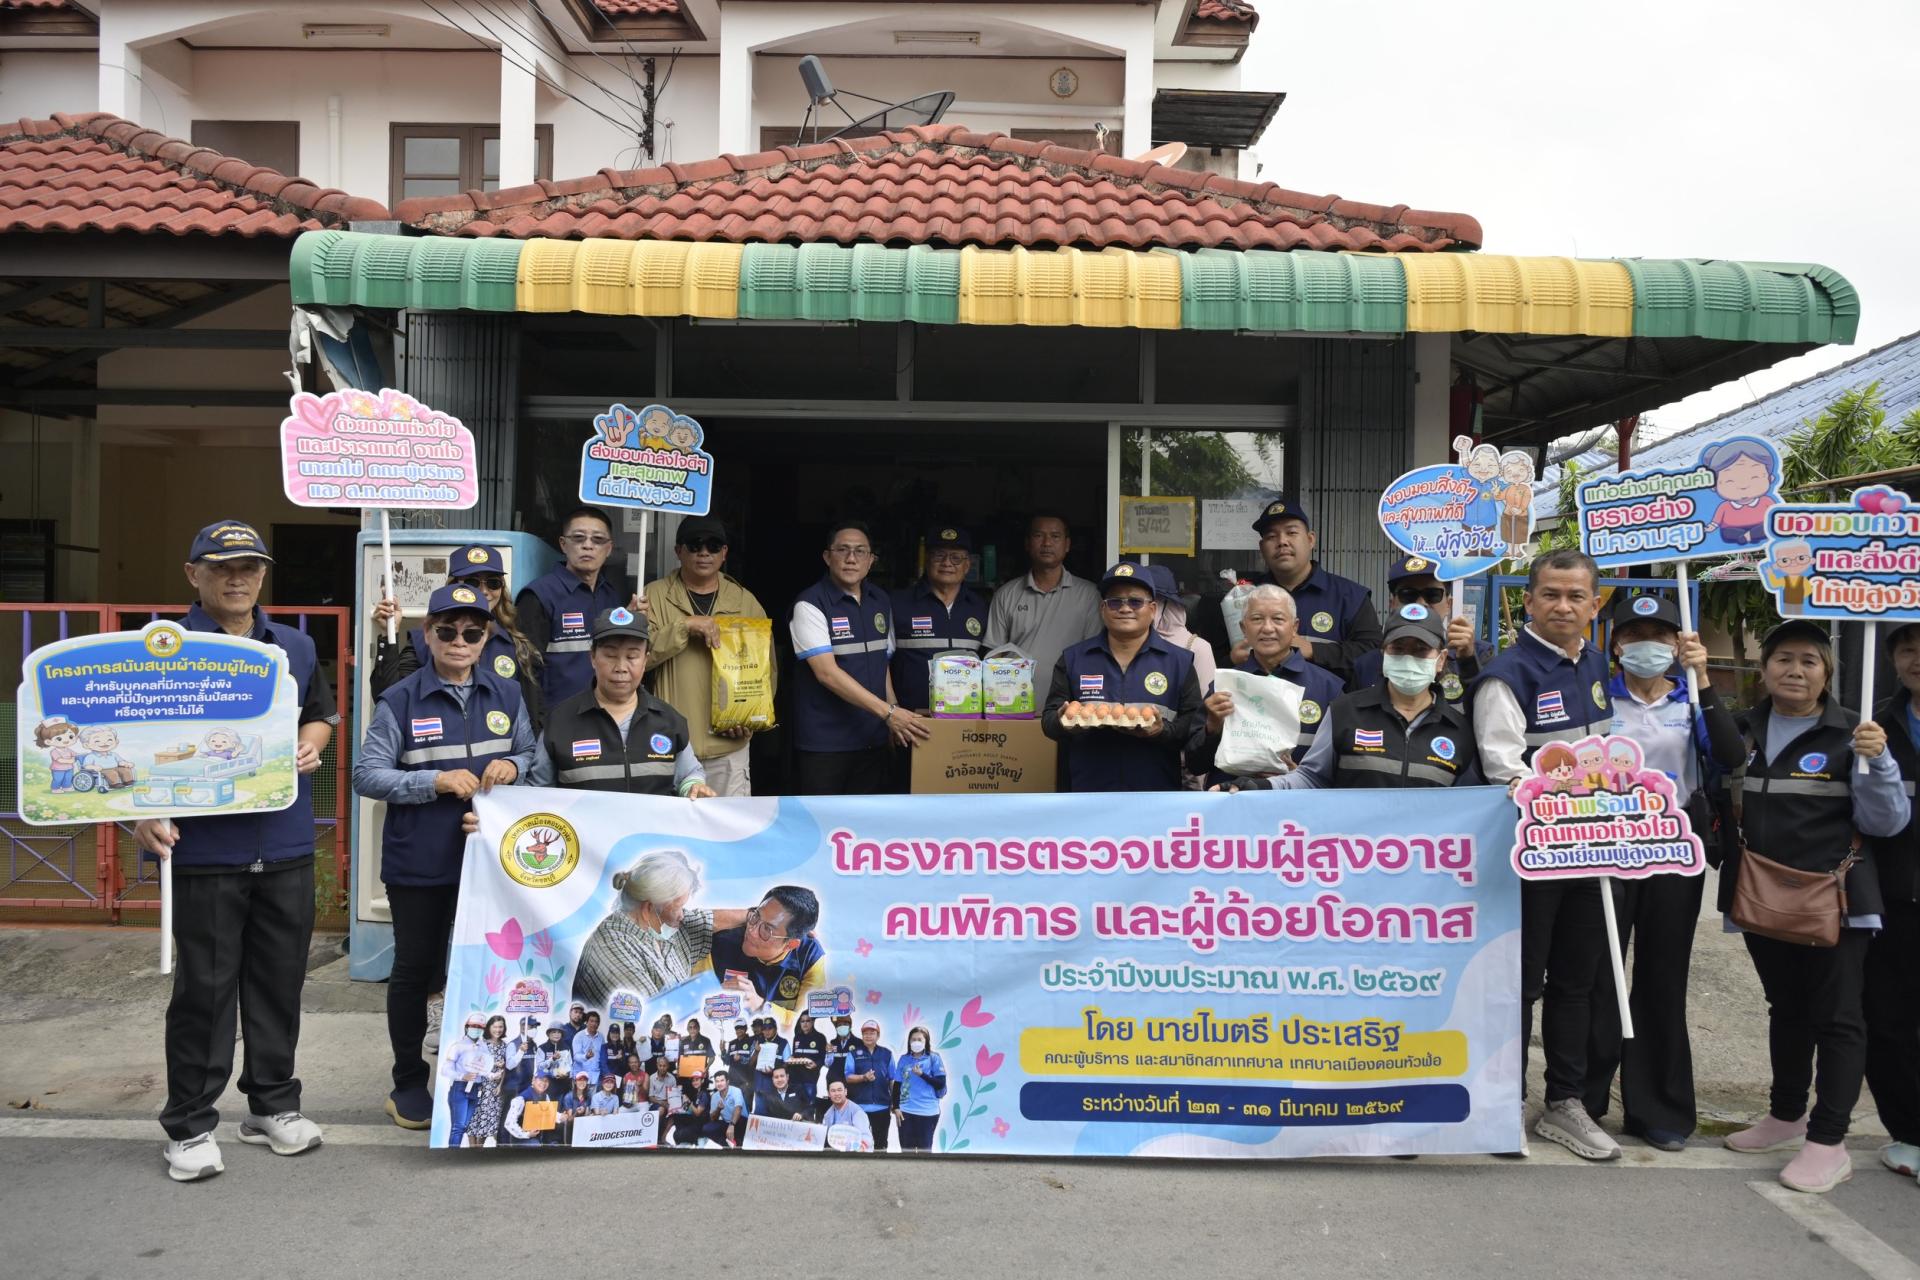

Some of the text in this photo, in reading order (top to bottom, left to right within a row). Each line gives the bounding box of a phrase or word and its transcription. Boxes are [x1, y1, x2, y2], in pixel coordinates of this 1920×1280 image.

[333, 416, 456, 437] ด้วยความห่วงใย
[299, 438, 462, 459] และปรารถนาดี จากใจ
[590, 443, 708, 474] ส่งมอบกำลังใจดีๆ
[370, 462, 464, 482] คณะผู้บริหาร
[611, 463, 687, 485] และสุขภาพ
[1586, 467, 1712, 501] แก่อย่างมีคุณค่า
[310, 484, 341, 497] และ
[599, 478, 693, 504] ที่ดีให้ผู้สูงวัย
[1383, 497, 1465, 528] และสุขภาพที่ดี
[1589, 498, 1692, 528] ชราอย่าง
[1590, 523, 1703, 554] มีความสุข
[1818, 544, 1920, 570] และสิ่งดี
[1813, 579, 1920, 609] ให้ผู้สูงวั
[44, 656, 271, 681] โครงการสนับสนุนผ้าอ้อมผู้ใหญ่
[85, 676, 232, 694] สำหรับบุคคลที่มีภาวะพึ่งพิง
[61, 689, 254, 708] และบุคคลที่มีปัญหาการกลั้นปัสสาวะ
[115, 704, 205, 720] หรืออุจจาระไม่ได้
[962, 733, 1007, 747] HOSPRO
[945, 762, 1023, 783] ผ้าอ้อมผู้ใหญ่
[1533, 789, 1663, 822] ผู้นำพร้อมใจ
[1529, 816, 1676, 848] คุณหมอห่วงใย
[831, 817, 1472, 882] โครงการตรวจเยี่ยมผู้สูงอายุ
[1523, 843, 1690, 866] ตรวจเยี่ยมผู้สูงอายุ
[886, 891, 1474, 949] คนพิการ และผู้ด้อยโอกาส
[1044, 962, 1441, 992] ประจำปีงบประมาณ พ.ศ. ๒๕๖๙
[1085, 1010, 1401, 1052] โดย นายไมตรี ประเสริฐ
[1044, 1050, 1129, 1068] คณะผู้บริหาร
[1135, 1053, 1283, 1069] และสมาชิกสภาเทศบาล
[1082, 1090, 1180, 1113] ระหว่างวันที่
[1186, 1100, 1220, 1115] ๒๓
[1242, 1104, 1272, 1117] ๓๑
[1279, 1098, 1338, 1118] มีนาคม
[1346, 1099, 1404, 1115] ๒๕๖๙
[589, 1129, 643, 1142] BRIDGESTONE
